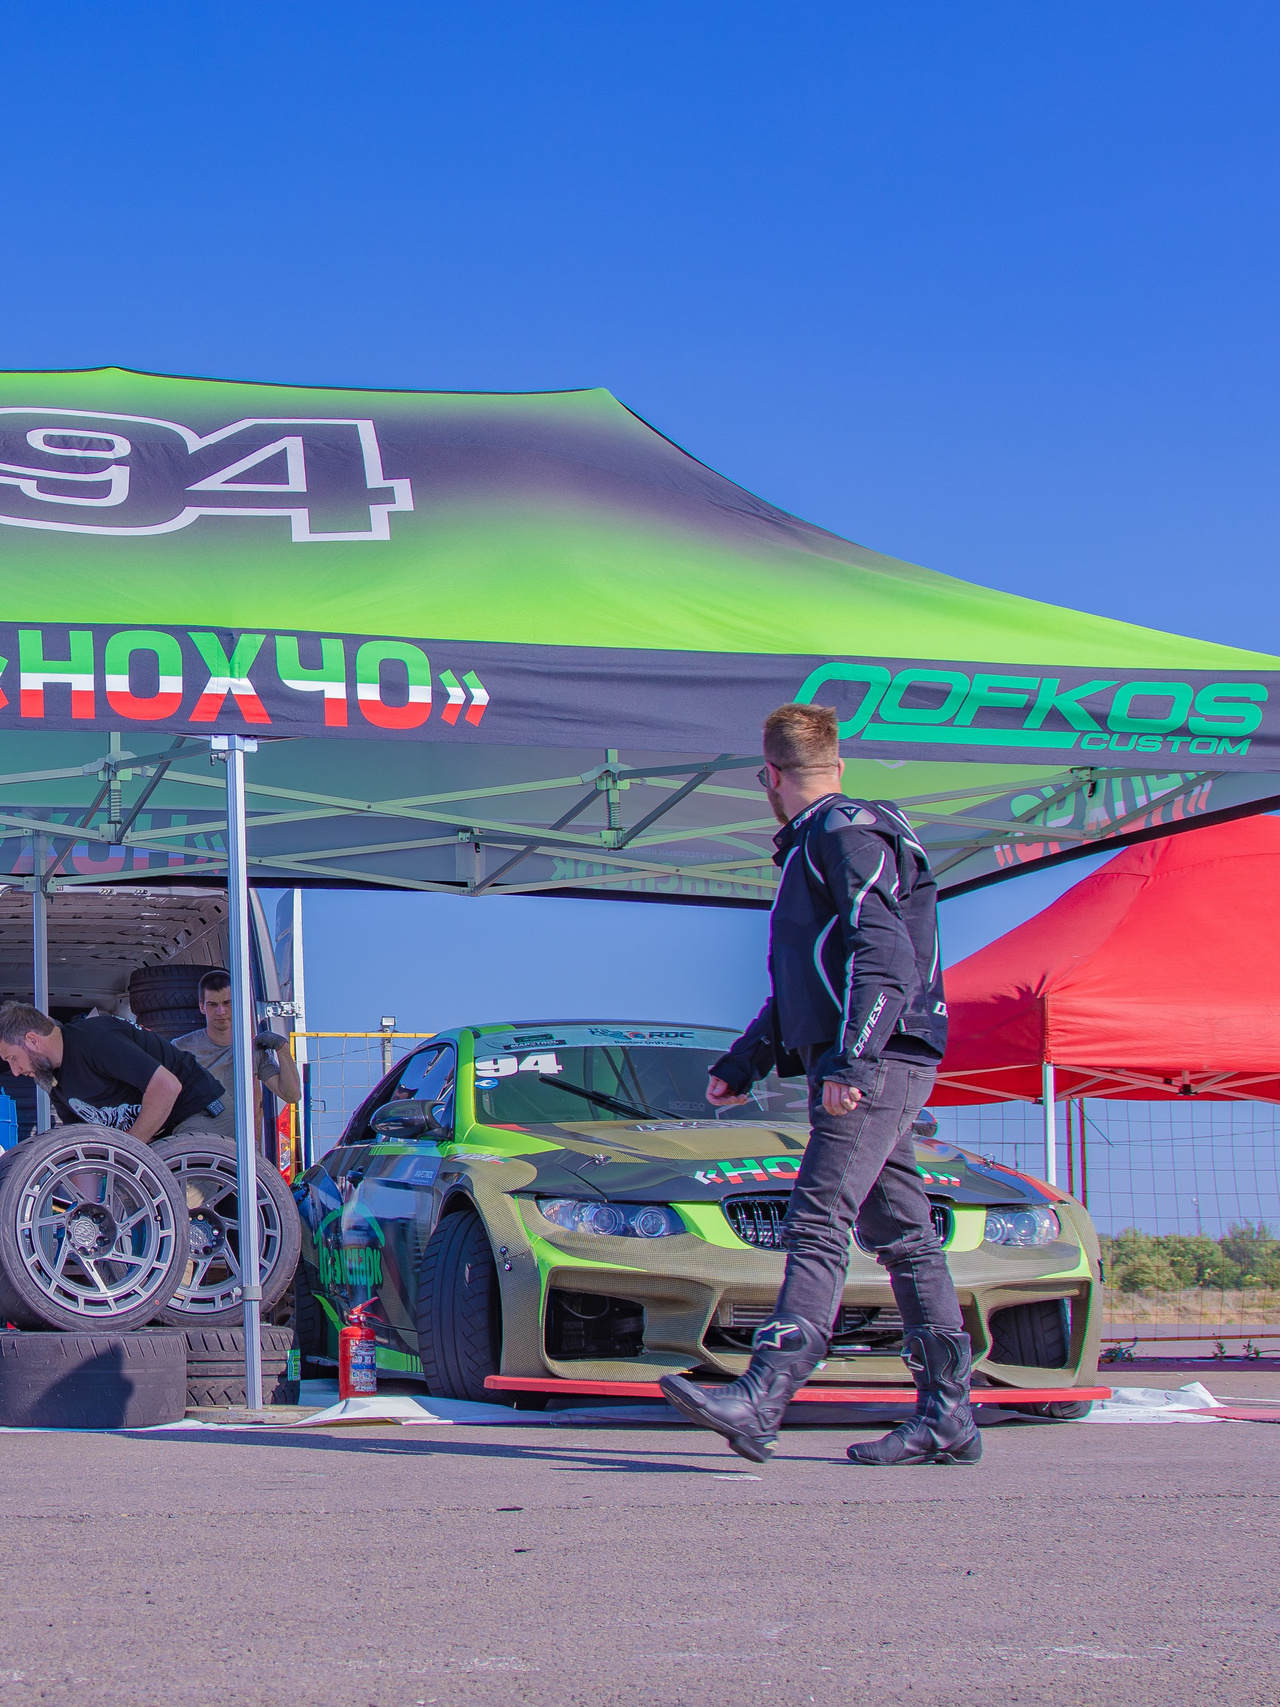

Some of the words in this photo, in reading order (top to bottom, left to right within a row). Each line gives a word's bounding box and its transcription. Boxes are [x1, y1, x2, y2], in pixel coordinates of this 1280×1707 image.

[1081, 732, 1252, 756] CUSTOM
[852, 992, 888, 1058] DAINESE
[475, 1052, 563, 1077] 94
